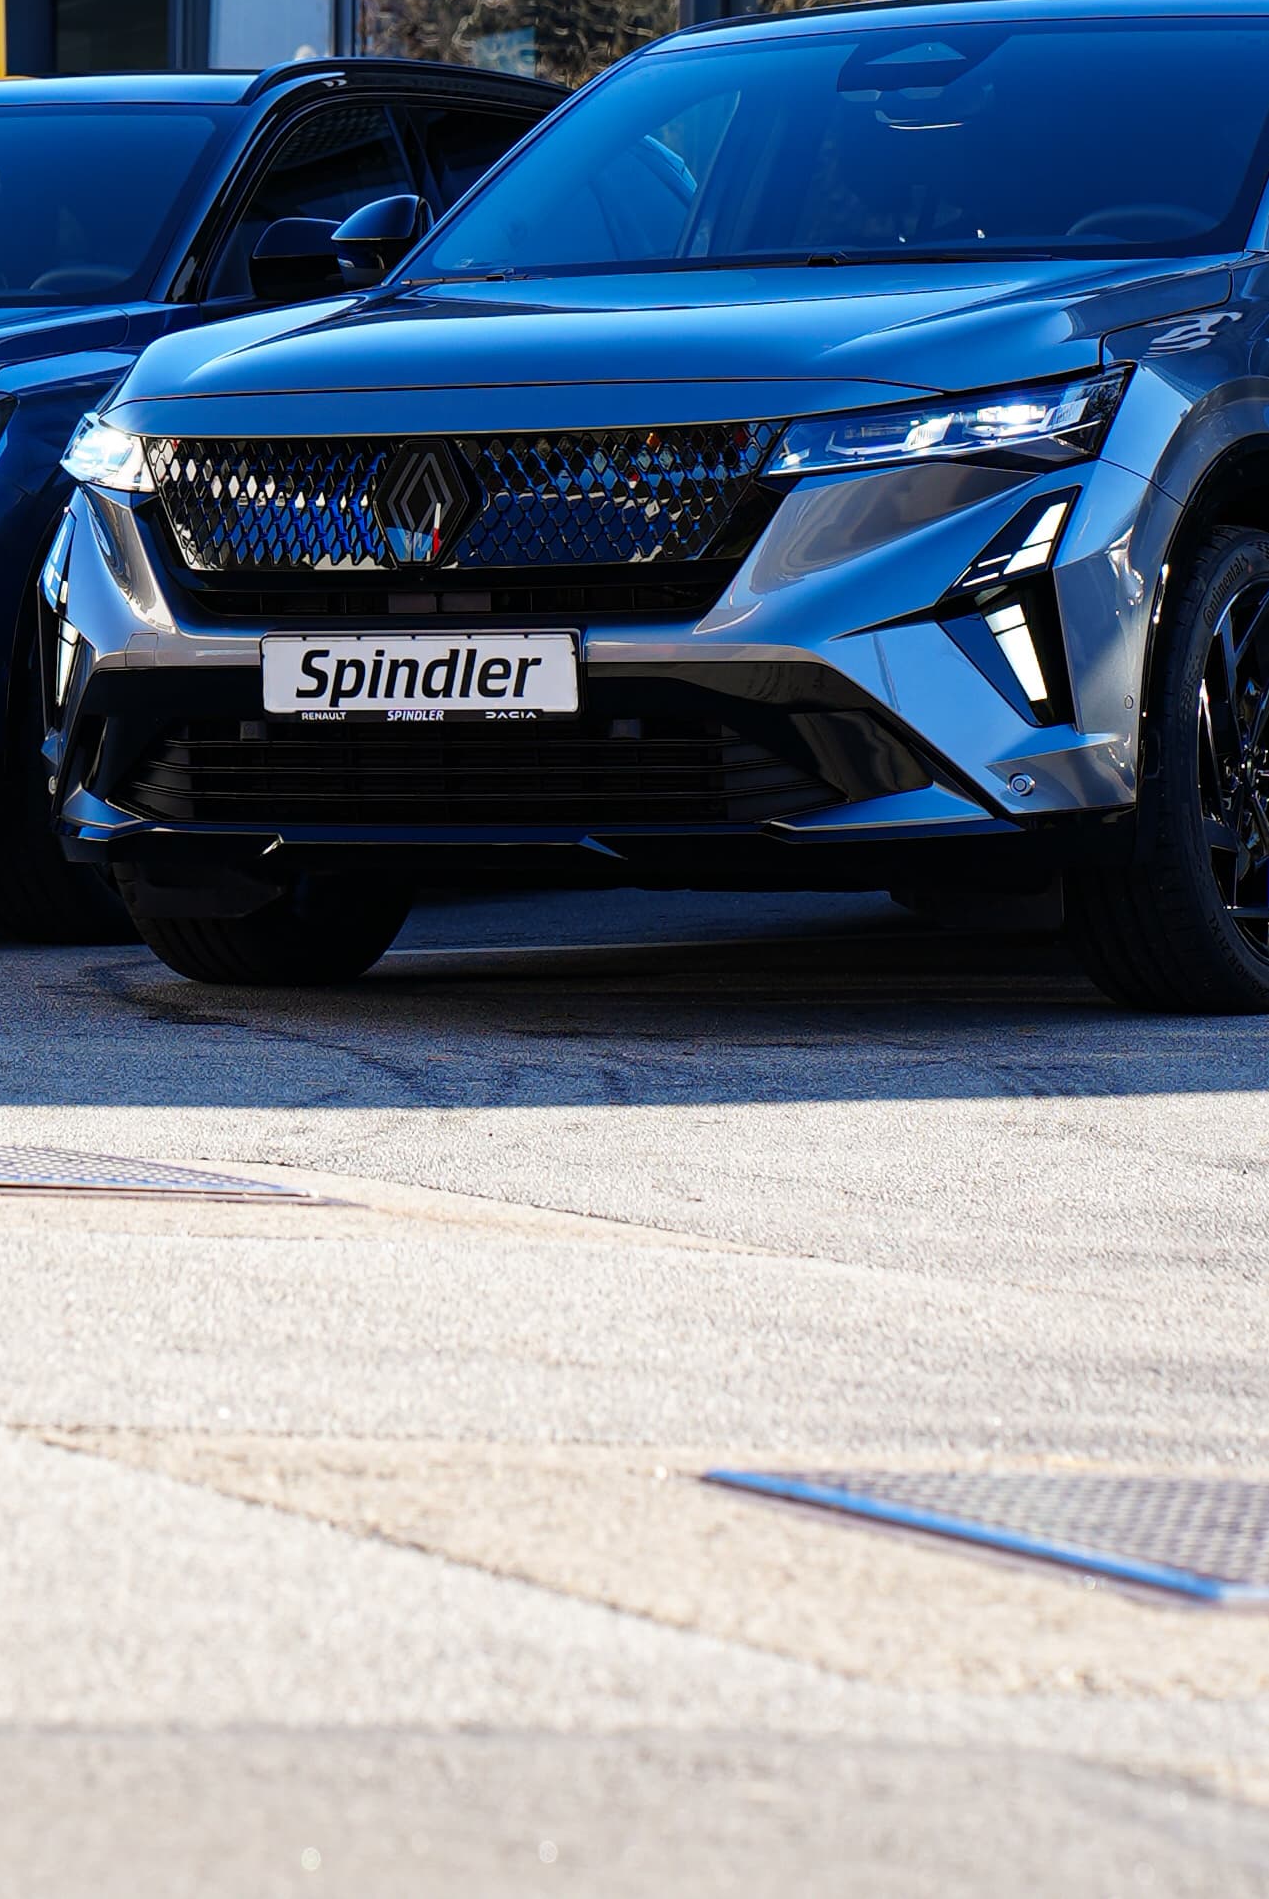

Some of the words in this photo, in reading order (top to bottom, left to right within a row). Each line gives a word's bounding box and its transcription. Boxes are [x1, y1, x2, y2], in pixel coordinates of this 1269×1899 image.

[295, 648, 542, 708] Spindler
[301, 711, 346, 720] RENAULT
[387, 709, 445, 722] SPINDLER
[485, 710, 537, 719] DACIA
